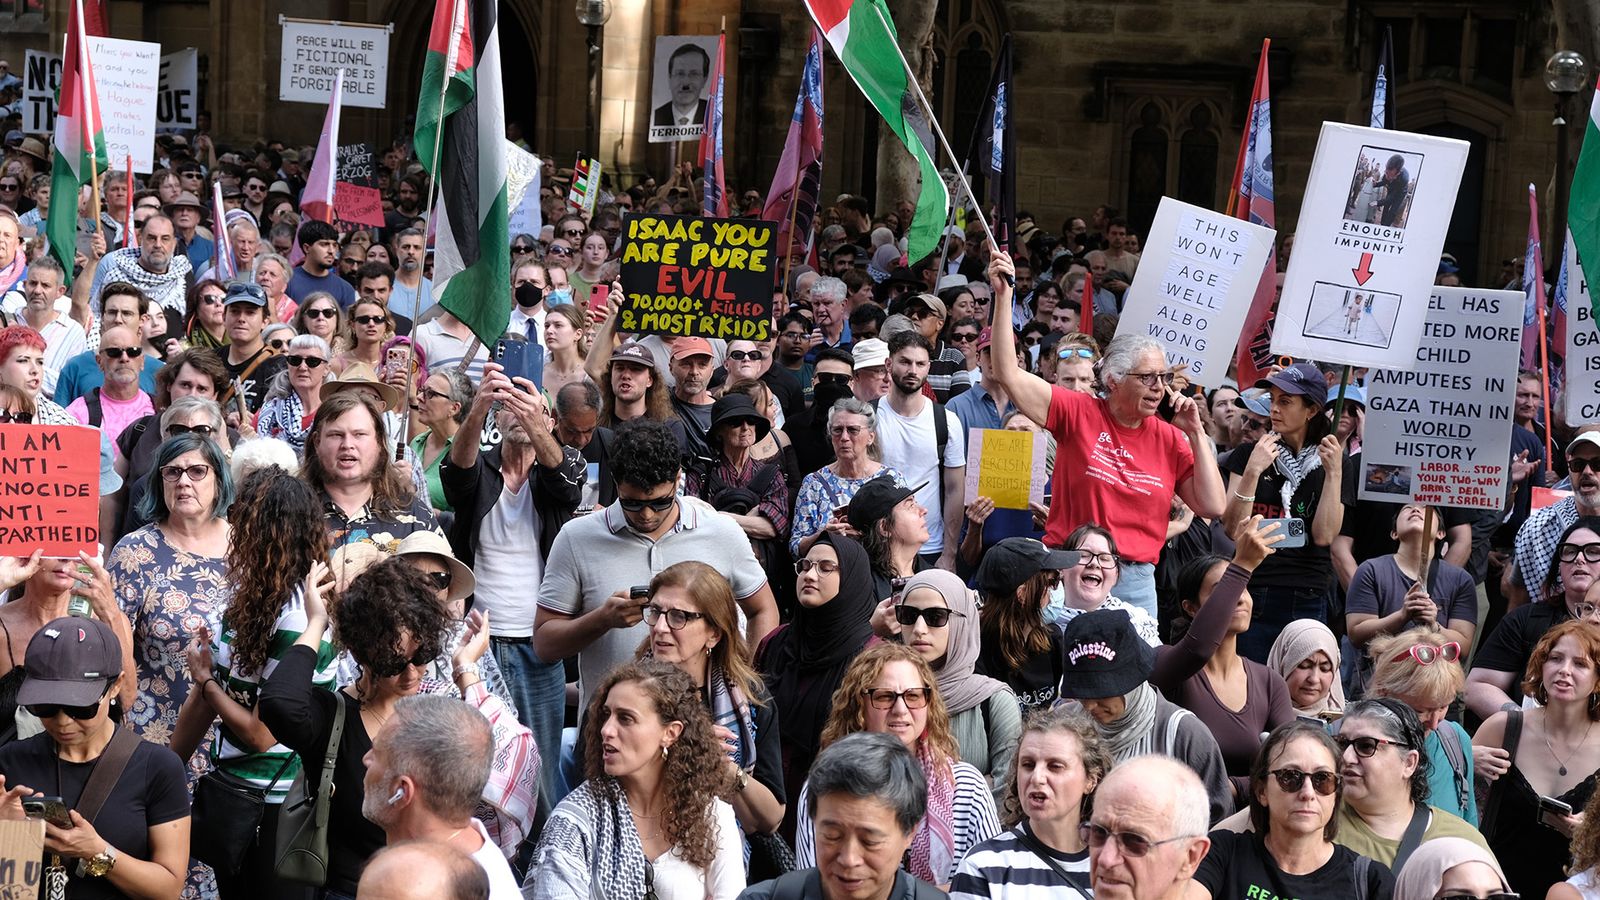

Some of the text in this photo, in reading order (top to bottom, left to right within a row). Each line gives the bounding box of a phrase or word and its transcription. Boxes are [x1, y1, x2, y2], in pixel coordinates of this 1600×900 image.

[296, 35, 374, 51] PEACE WILL BE
[296, 48, 372, 66] FICTIONAL
[292, 63, 375, 79] IF GENOCDE IS
[290, 76, 375, 95] FORGIABLE
[104, 125, 145, 137] ustralia
[651, 127, 704, 137] TERRORIS
[336, 165, 372, 180] ERZOG
[628, 217, 771, 248] ISAAC YOU
[1195, 218, 1240, 243] THIS
[1342, 222, 1402, 240] ENOUGH
[1178, 235, 1242, 266] WON'T
[1334, 237, 1404, 255] IMPUNITY
[622, 242, 768, 272] ARE PURE
[1178, 265, 1219, 287] AGE
[1167, 282, 1216, 309] WELL
[1462, 296, 1500, 314] HAS
[621, 309, 638, 331] &
[641, 313, 697, 336] MOST
[1157, 305, 1208, 331] ALBO
[1149, 323, 1207, 352] WONG
[1464, 325, 1519, 343] MORE
[1416, 347, 1471, 364] CHILD
[1372, 369, 1505, 393] AMPUTEES IN
[1370, 396, 1509, 420] GAZA THAN IN
[1403, 420, 1472, 438] WORLD
[0, 431, 61, 451] I AM
[983, 437, 1029, 453] WE ARE
[1395, 441, 1477, 461] HISTORY
[1474, 465, 1502, 474] STOP
[986, 476, 1019, 490] RIGHTS
[1416, 473, 1500, 486] YOUR TWO-WAY
[1420, 484, 1487, 496] ARMS DEAL
[1414, 494, 1500, 509] WITH ISRAEL!
[0, 526, 97, 544] PARTHEID
[1068, 641, 1116, 666] palestine
